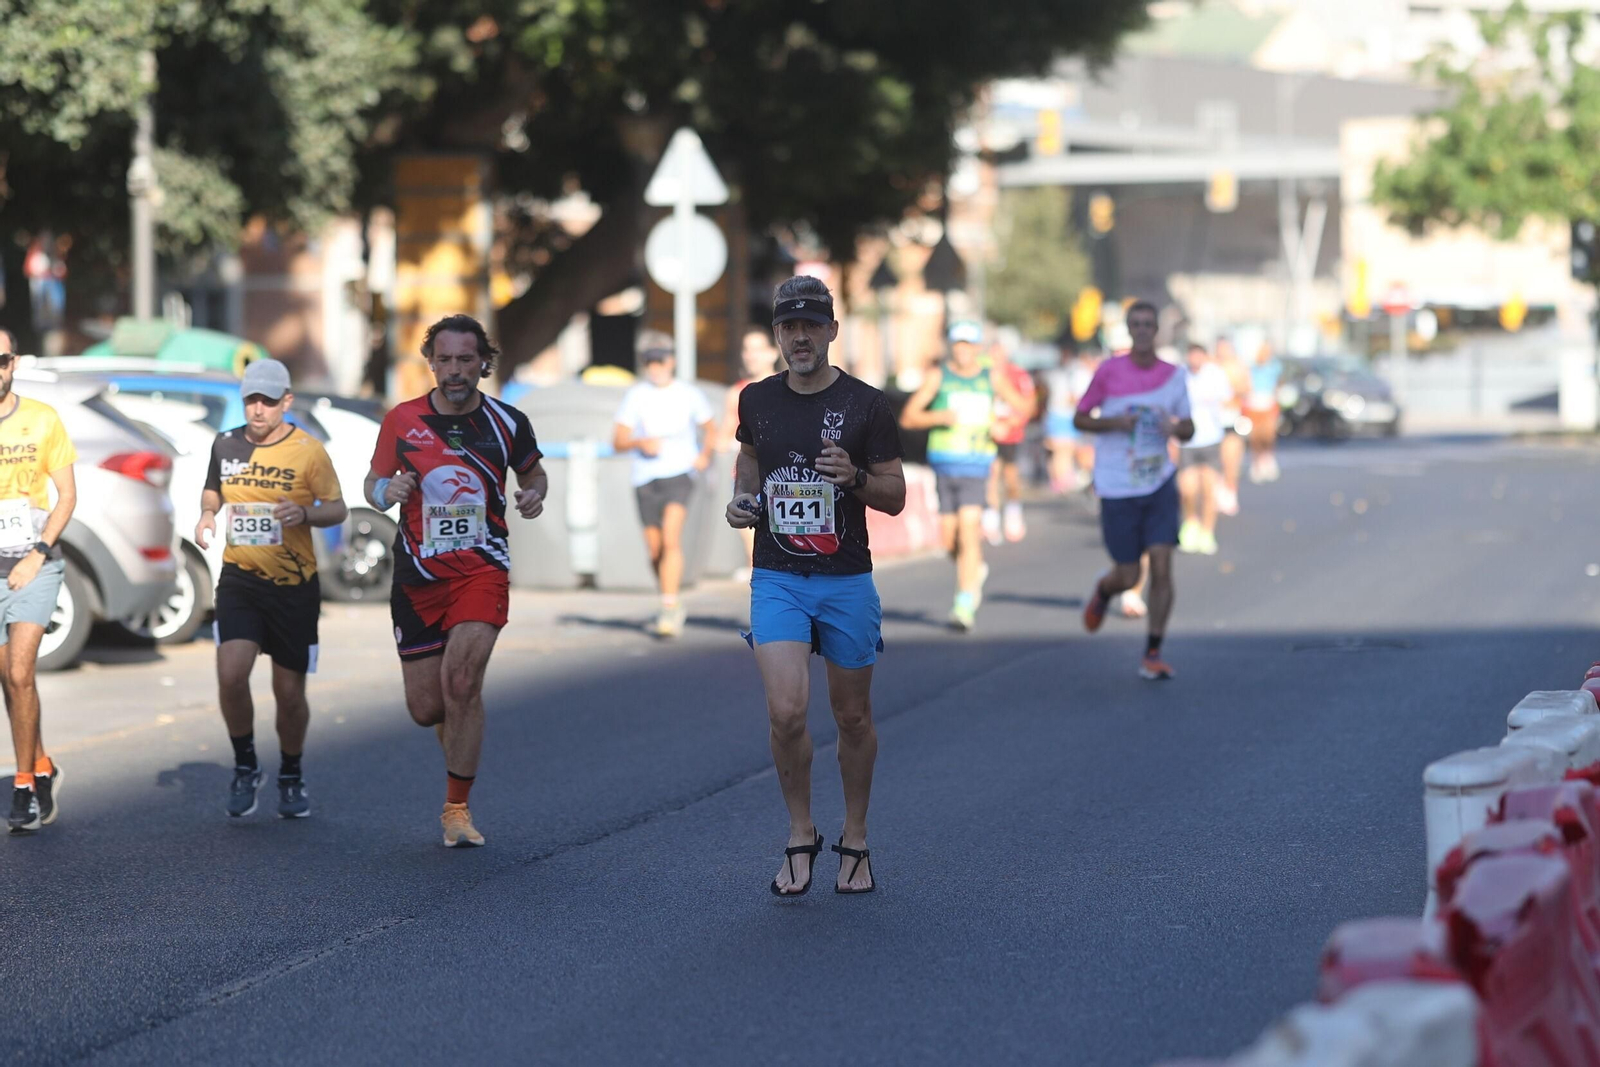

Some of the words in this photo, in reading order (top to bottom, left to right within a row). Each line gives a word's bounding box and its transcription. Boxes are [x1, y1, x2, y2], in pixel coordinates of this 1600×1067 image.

[821, 429, 842, 439] OTSO
[788, 451, 807, 463] The
[220, 458, 296, 480] bichos
[220, 475, 293, 492] runners
[775, 501, 821, 519] 141
[234, 518, 272, 532] 338
[438, 518, 470, 536] 26
